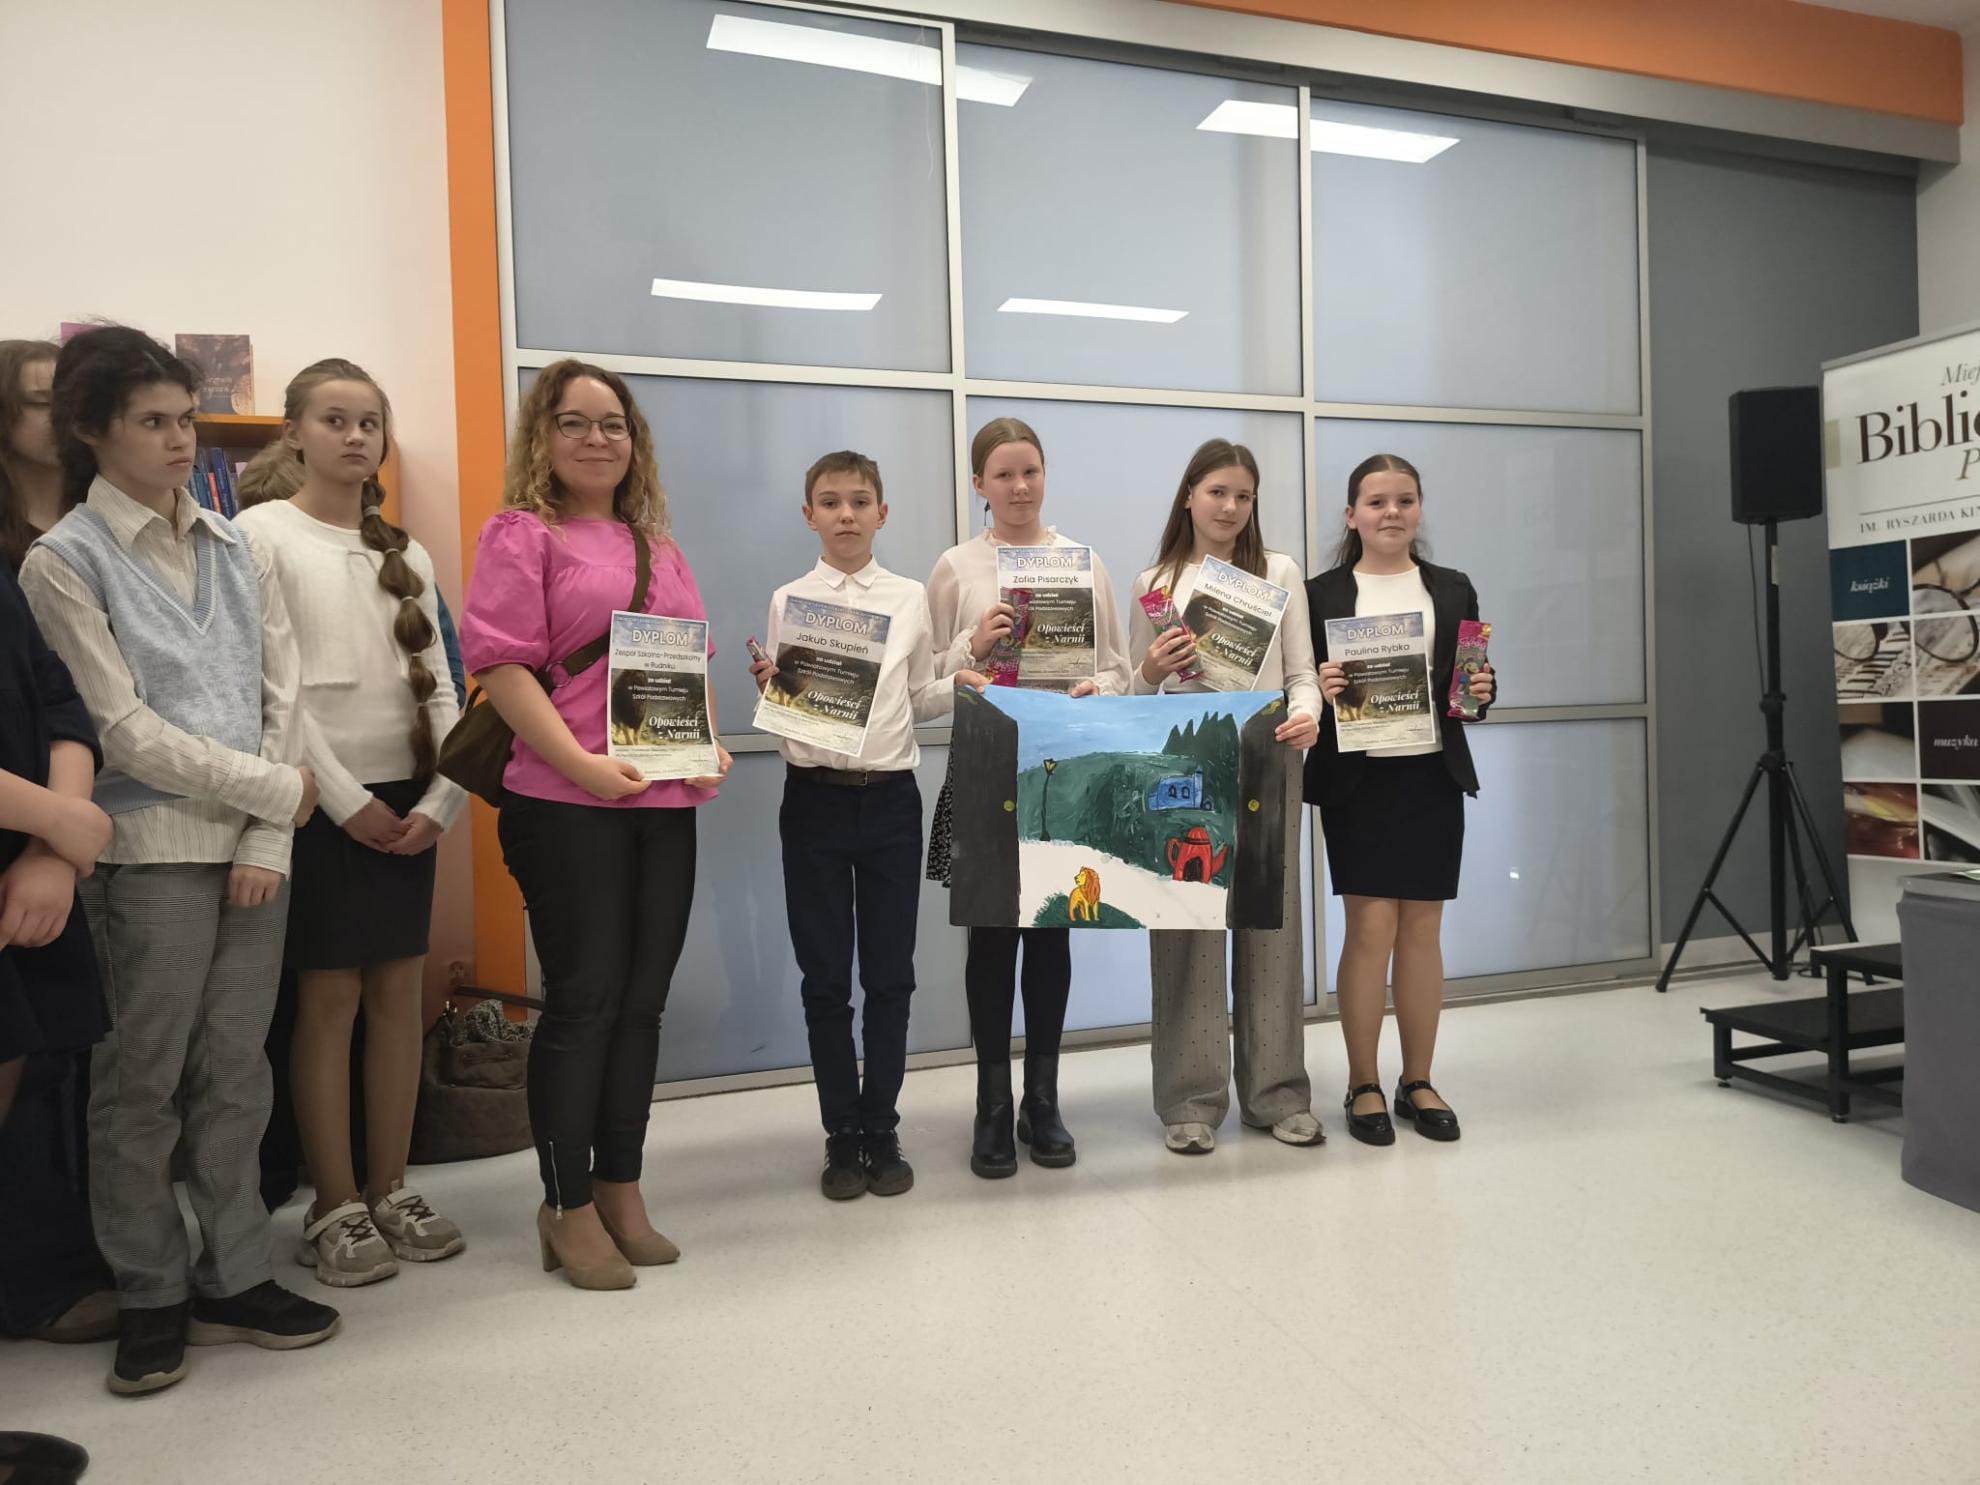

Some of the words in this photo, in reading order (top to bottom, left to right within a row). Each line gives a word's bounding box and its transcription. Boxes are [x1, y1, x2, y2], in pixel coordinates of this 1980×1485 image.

[1886, 510, 1955, 530] RYSZARDA
[1017, 556, 1072, 568] DYPLOM
[1013, 575, 1036, 584] Zofia
[1038, 575, 1079, 585] Pisarczyk
[1218, 572, 1271, 601] DYPLOM
[1204, 583, 1232, 600] Milena
[806, 611, 868, 635] DYPLOM
[1037, 623, 1085, 634] Opowieści
[632, 628, 688, 646] DYPLOM
[1051, 634, 1085, 644] Narnii
[1347, 624, 1404, 640] DYPLOM
[796, 632, 827, 646] Jakub
[829, 639, 868, 655] Skupień
[1211, 632, 1257, 657] Opowieści
[1344, 646, 1379, 656] Paulina
[1381, 643, 1410, 654] Rybka
[1220, 648, 1253, 666] Narnii
[651, 661, 676, 669] Rudniku
[808, 690, 861, 709] Opowieści
[1370, 690, 1419, 704] Opowieści
[820, 704, 858, 719] Narnii
[1386, 701, 1420, 712] Narnii
[649, 716, 698, 728] Opowieści
[665, 729, 700, 740] Narnii
